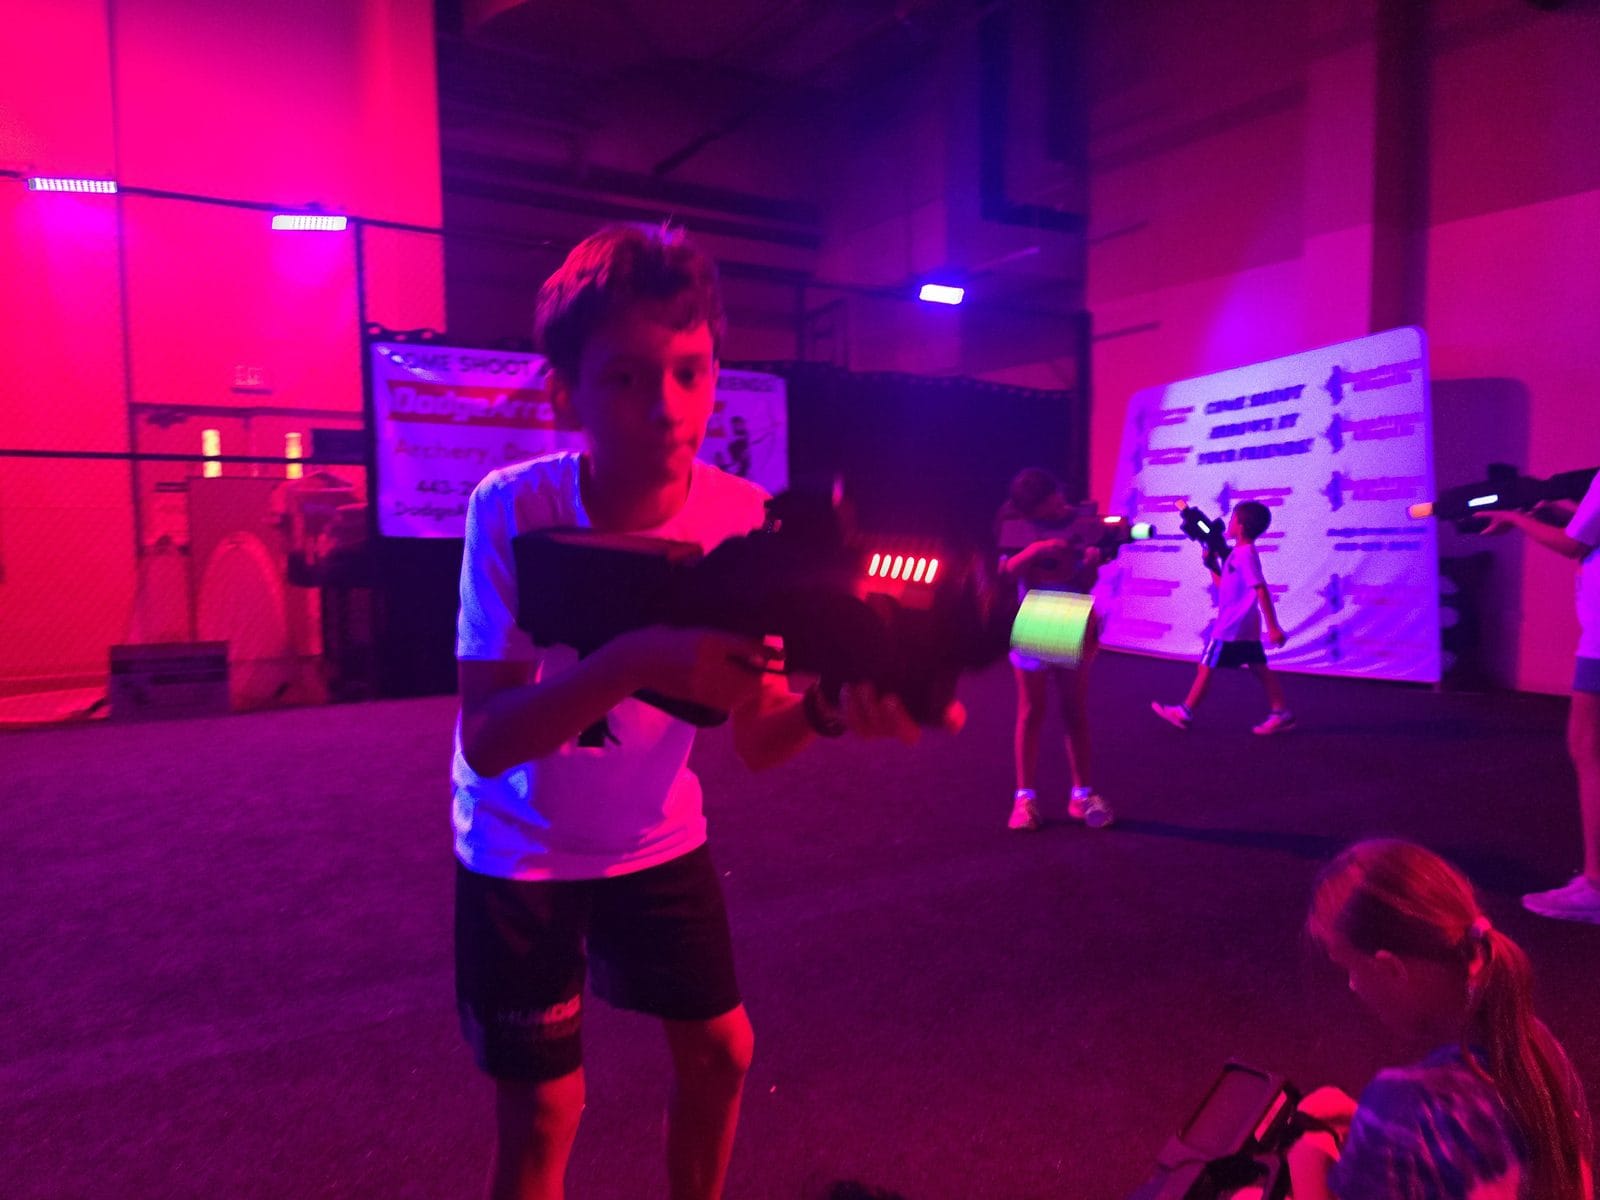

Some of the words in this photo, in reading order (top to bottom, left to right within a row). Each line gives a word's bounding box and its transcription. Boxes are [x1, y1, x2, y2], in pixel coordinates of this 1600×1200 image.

[457, 355, 529, 376] SHOOT
[393, 385, 556, 423] DodgeArro
[415, 479, 478, 496] 443-2
